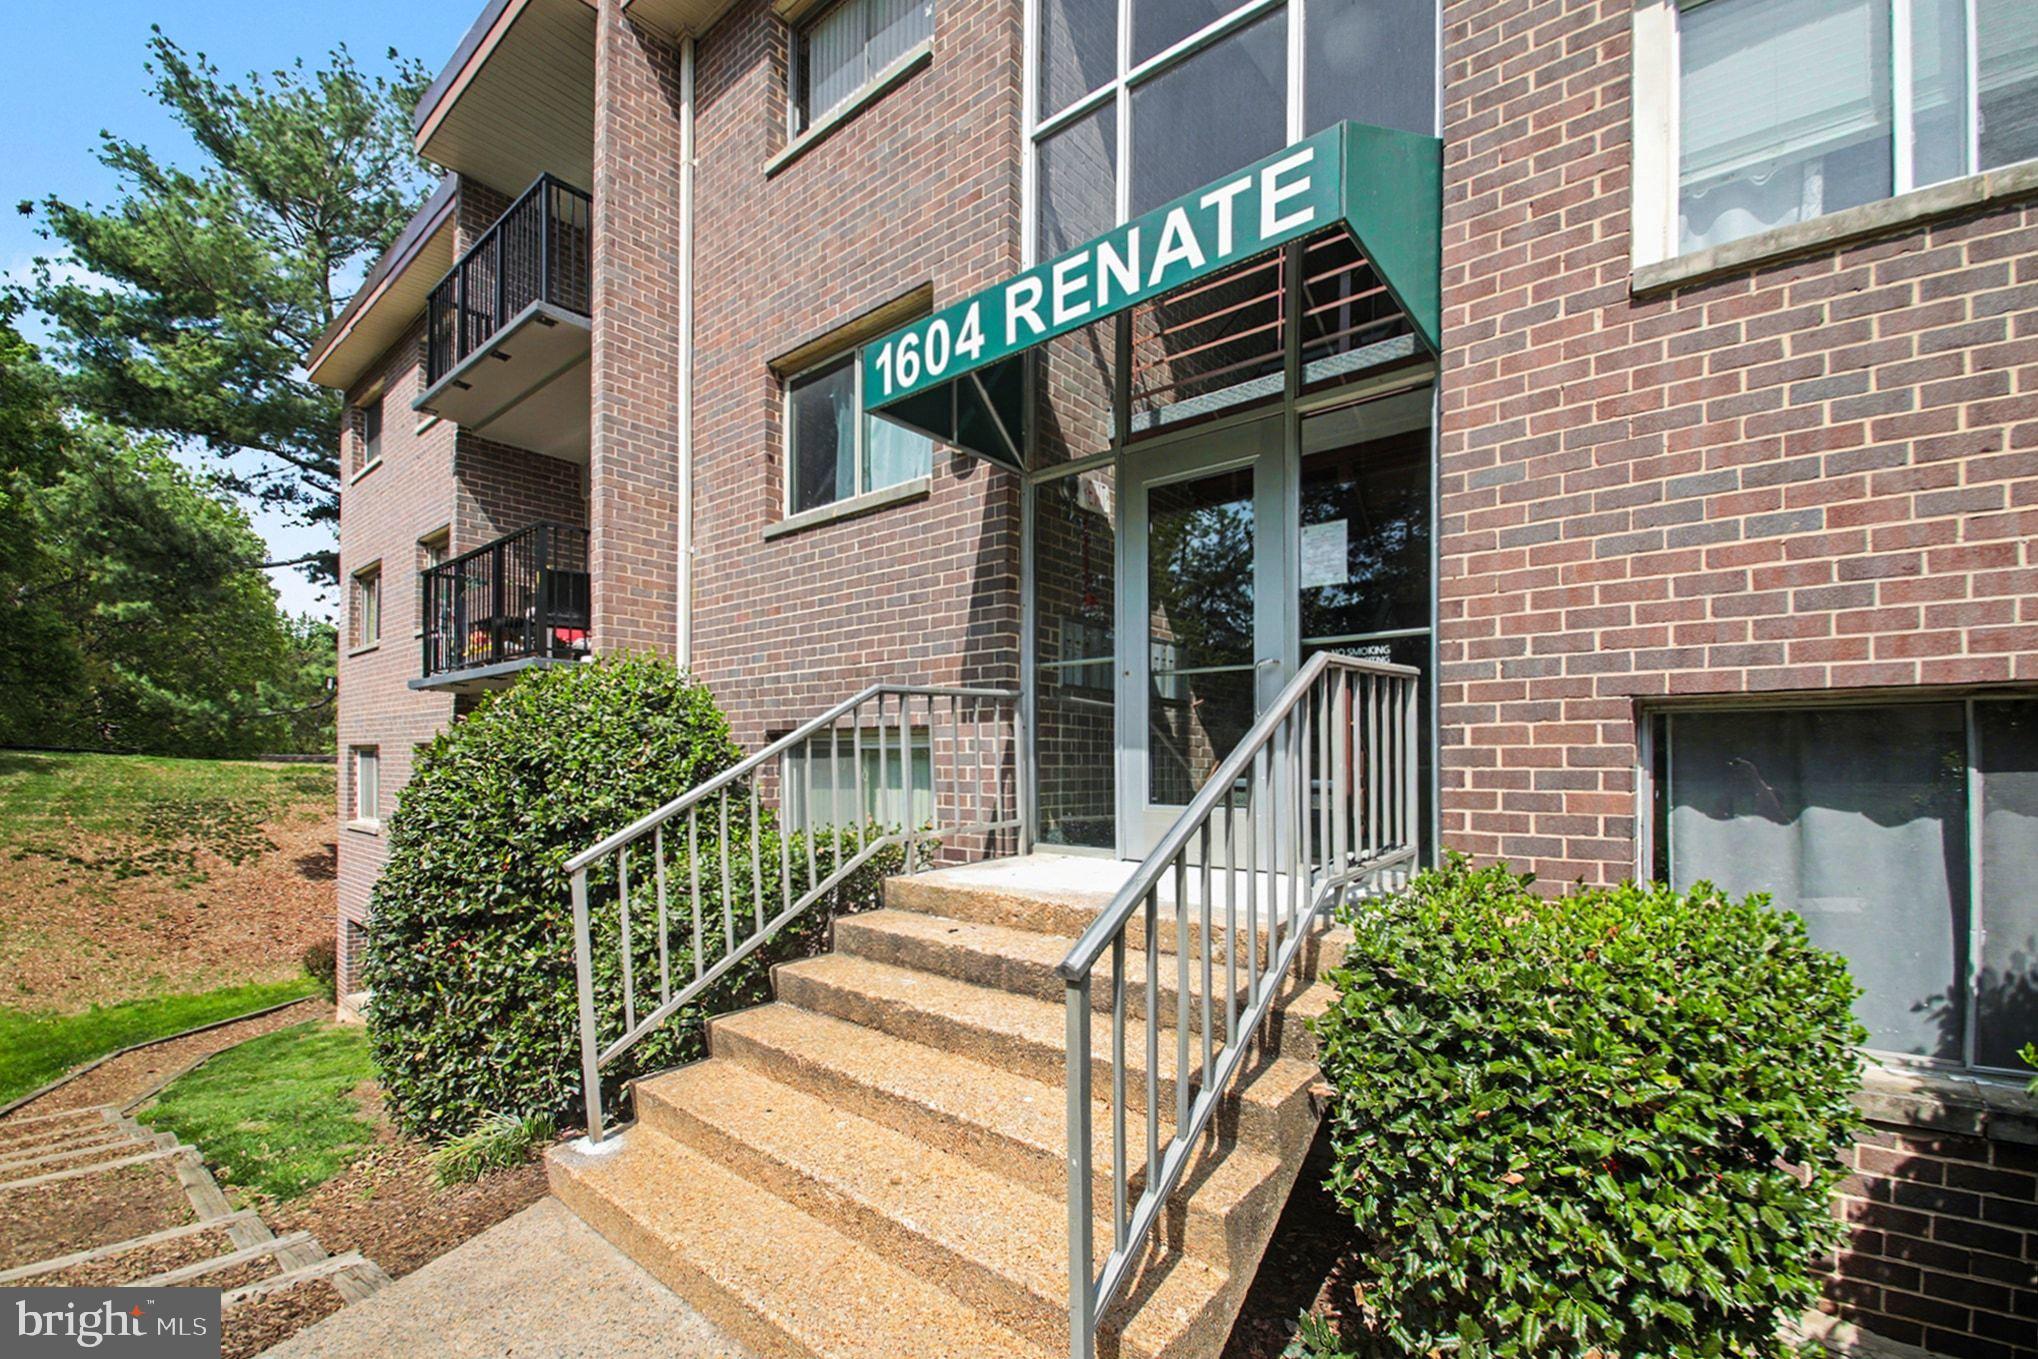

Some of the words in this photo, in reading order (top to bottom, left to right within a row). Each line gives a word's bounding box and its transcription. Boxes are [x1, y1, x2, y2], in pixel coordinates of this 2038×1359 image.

[875, 300, 985, 396] 1604
[1006, 146, 1314, 346] RENATE
[1347, 644, 1391, 657] SMOKING
